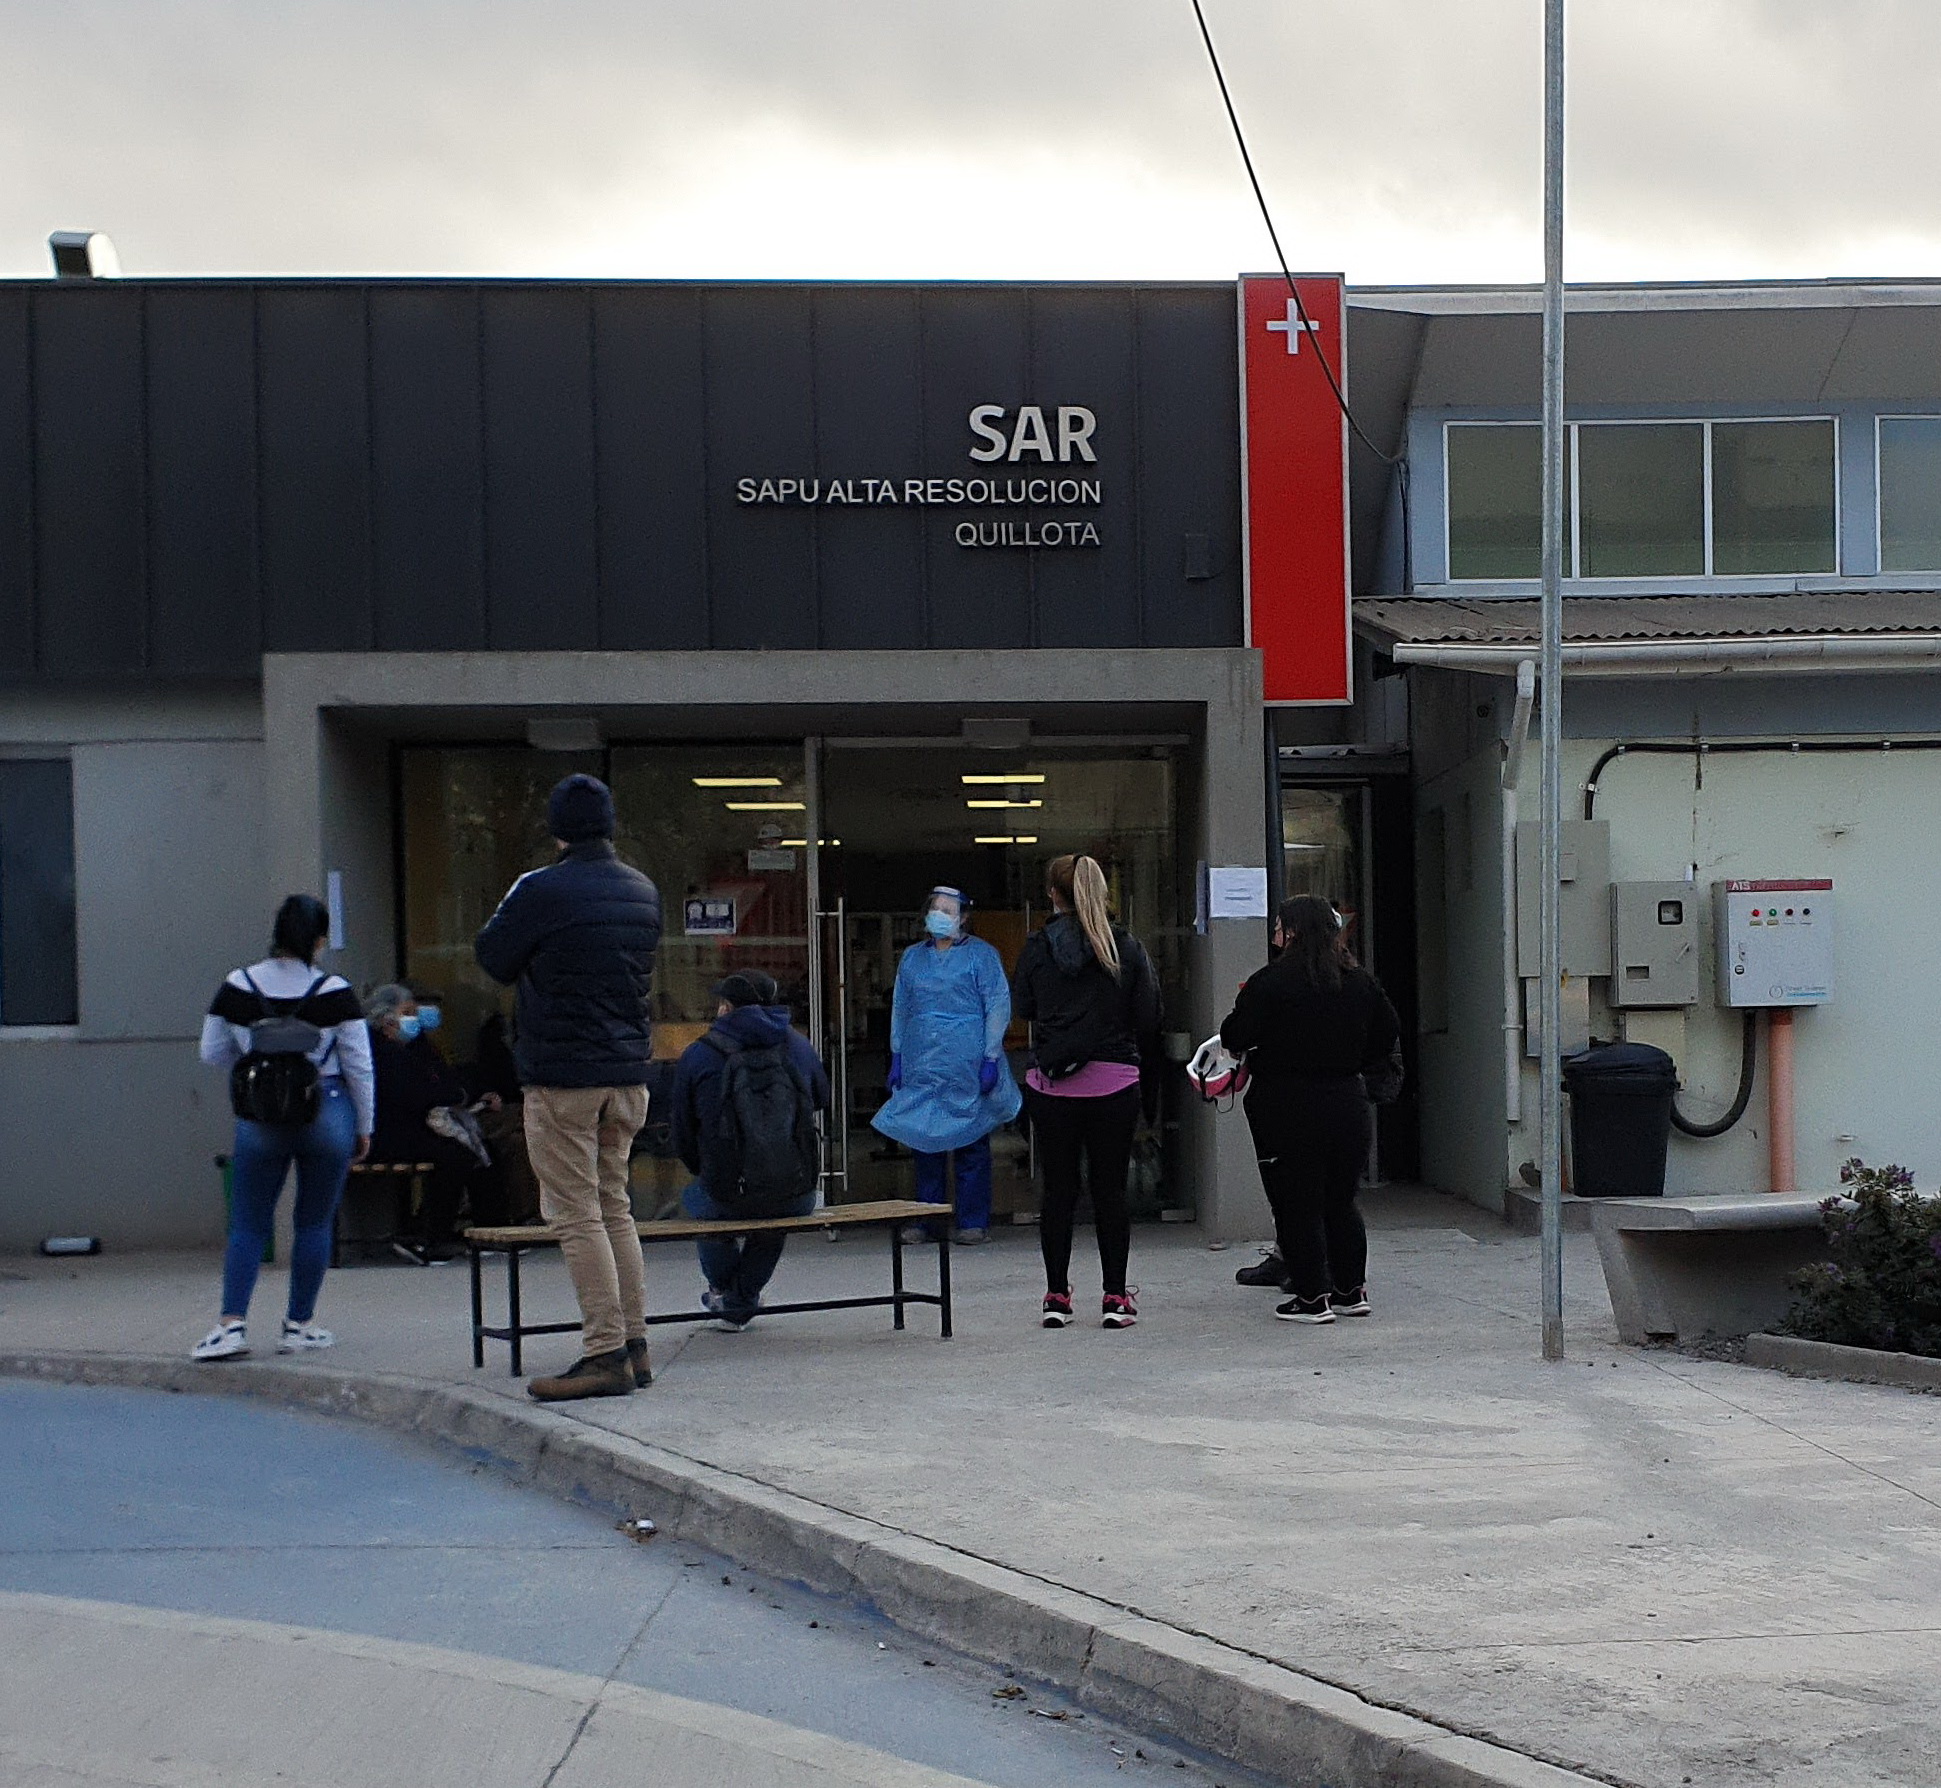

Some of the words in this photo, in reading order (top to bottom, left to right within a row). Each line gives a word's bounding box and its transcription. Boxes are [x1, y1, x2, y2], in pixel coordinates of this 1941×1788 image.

[968, 403, 1098, 463] SAR
[736, 478, 819, 504] SAPU
[825, 478, 899, 504] ALTA
[904, 478, 1102, 505] RESOLUCION
[954, 521, 1101, 547] QUILLOTA
